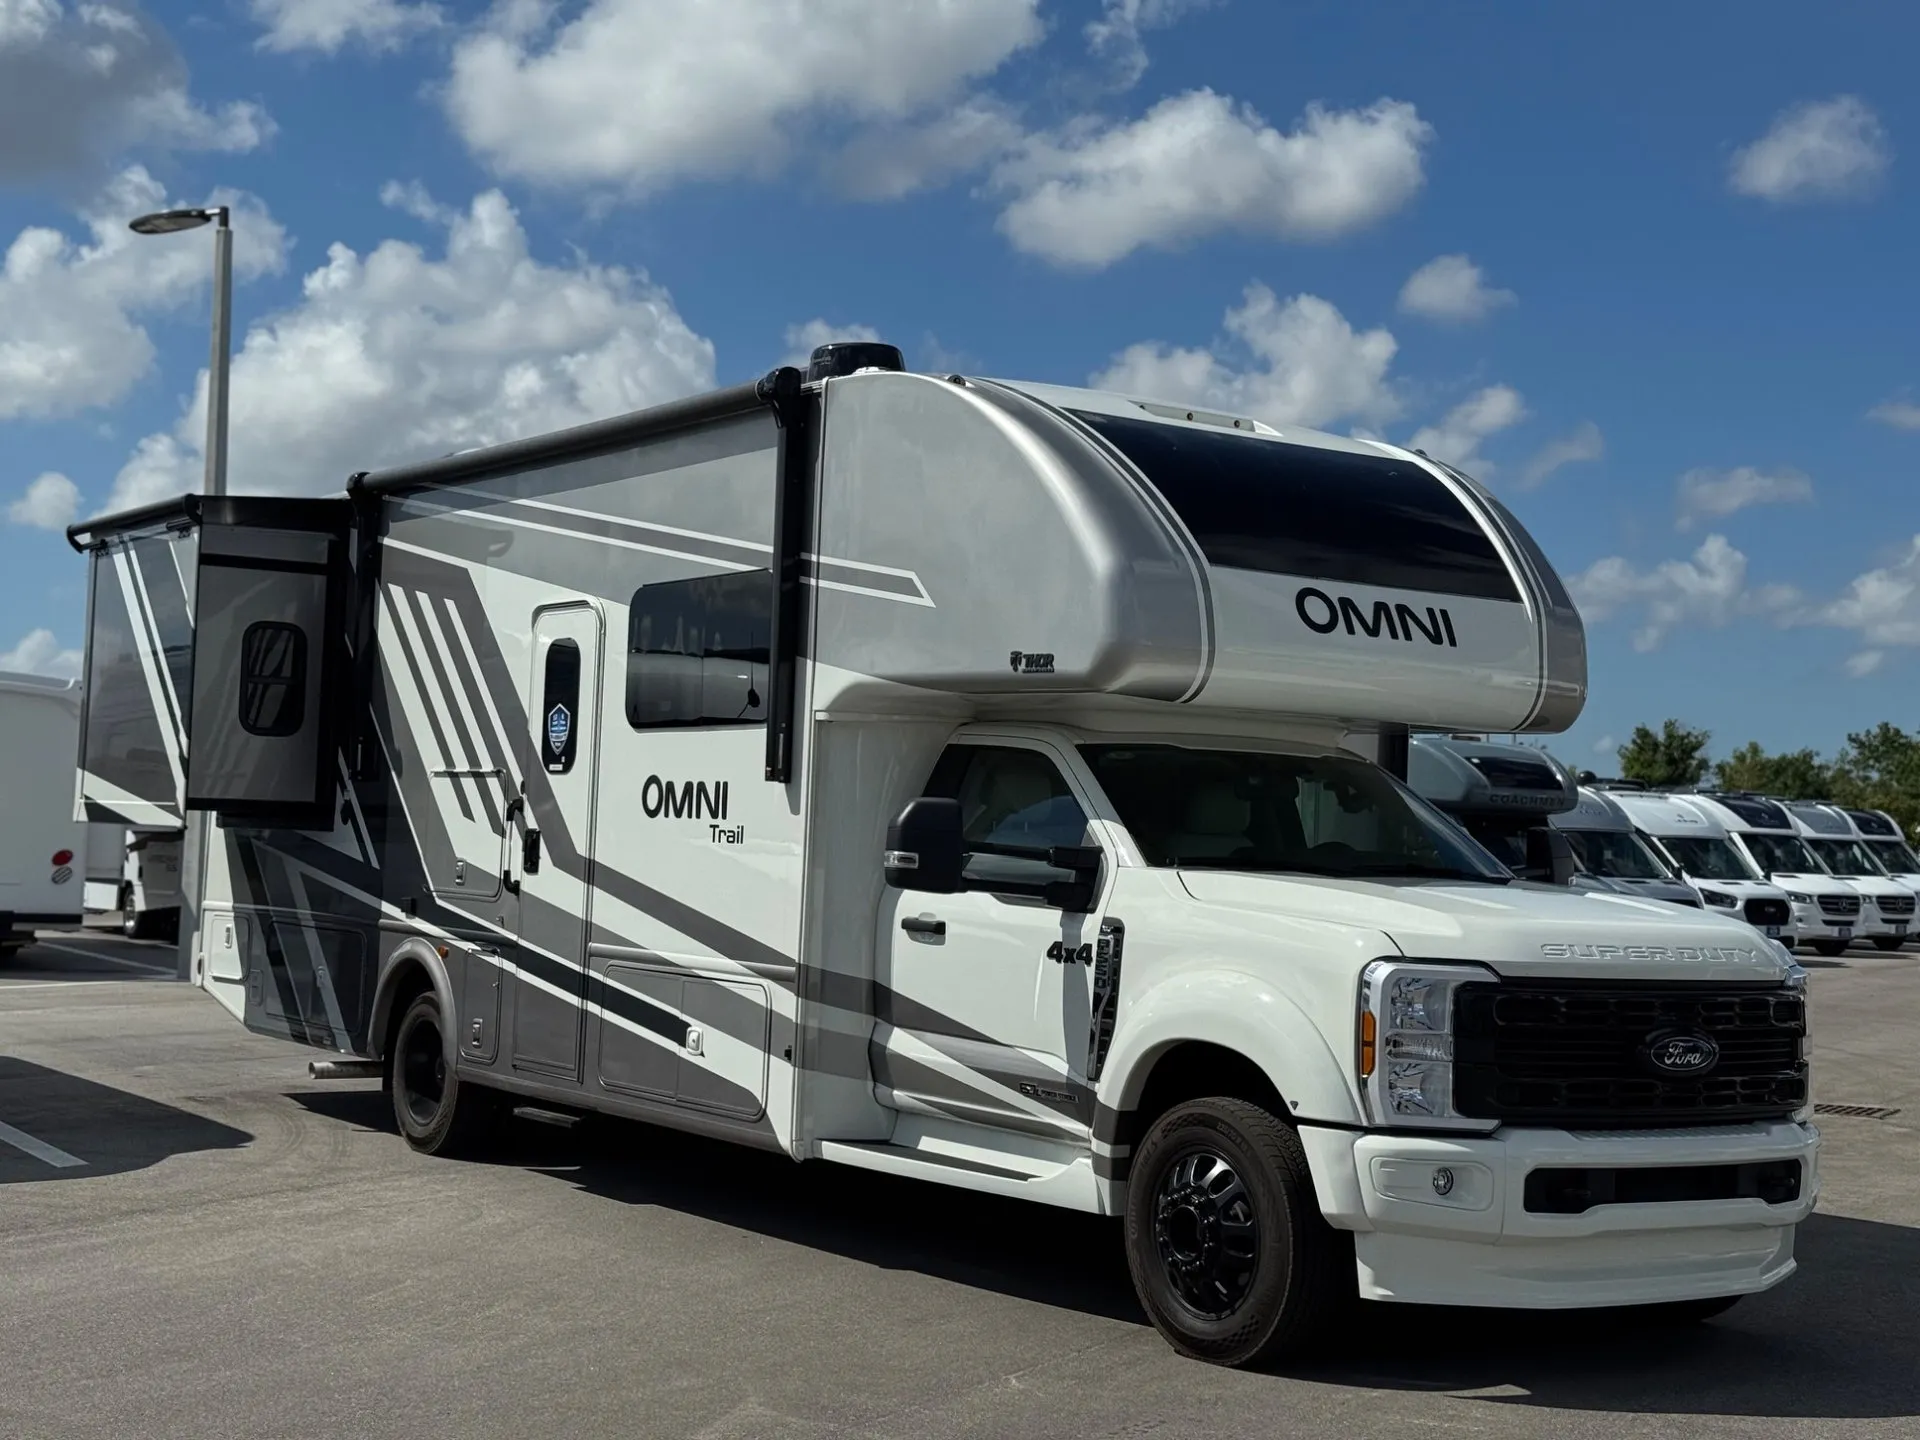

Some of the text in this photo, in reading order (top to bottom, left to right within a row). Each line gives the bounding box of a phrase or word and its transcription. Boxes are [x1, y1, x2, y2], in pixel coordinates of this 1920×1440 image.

[1295, 587, 1457, 648] OMNI
[1022, 653, 1055, 668] THOR
[641, 774, 729, 820] OMNI
[709, 824, 744, 844] Trail
[1046, 940, 1093, 967] 4x4
[1540, 943, 1758, 963] SUPER DUTY
[1664, 1041, 1706, 1065] Ford
